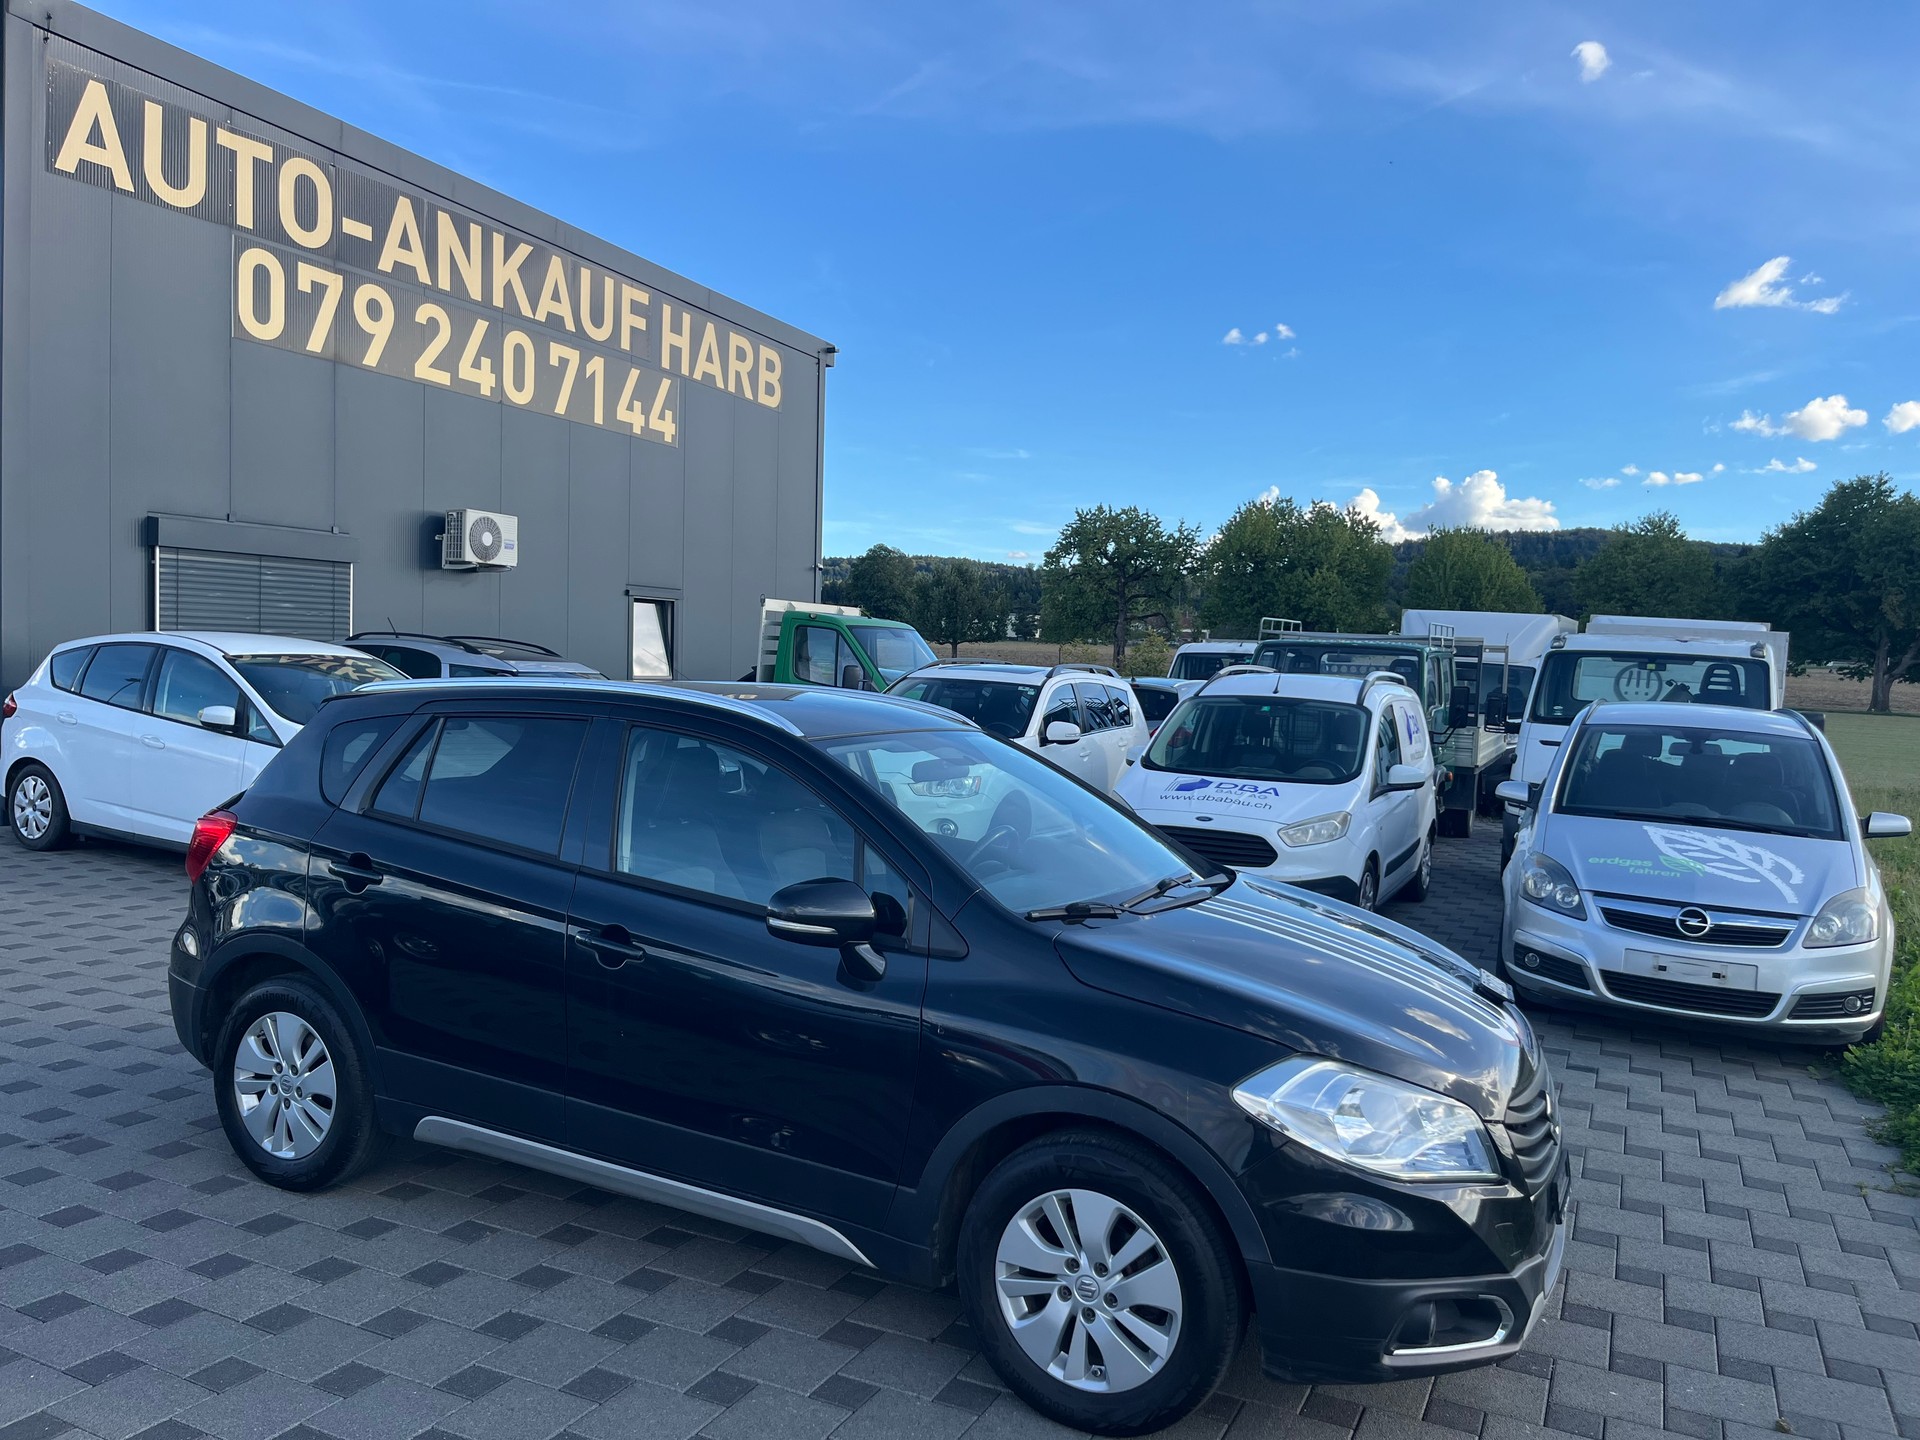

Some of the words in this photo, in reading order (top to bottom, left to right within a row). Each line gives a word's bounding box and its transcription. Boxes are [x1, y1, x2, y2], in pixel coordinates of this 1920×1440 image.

[56, 80, 649, 350] AUTO-ANKAUF
[661, 304, 782, 407] HARB
[238, 247, 395, 368] 079
[1214, 782, 1280, 797] DBA
[1159, 794, 1272, 810] www.dbabau.ch
[1588, 857, 1653, 867] erdgas
[1628, 866, 1680, 878] fahren
